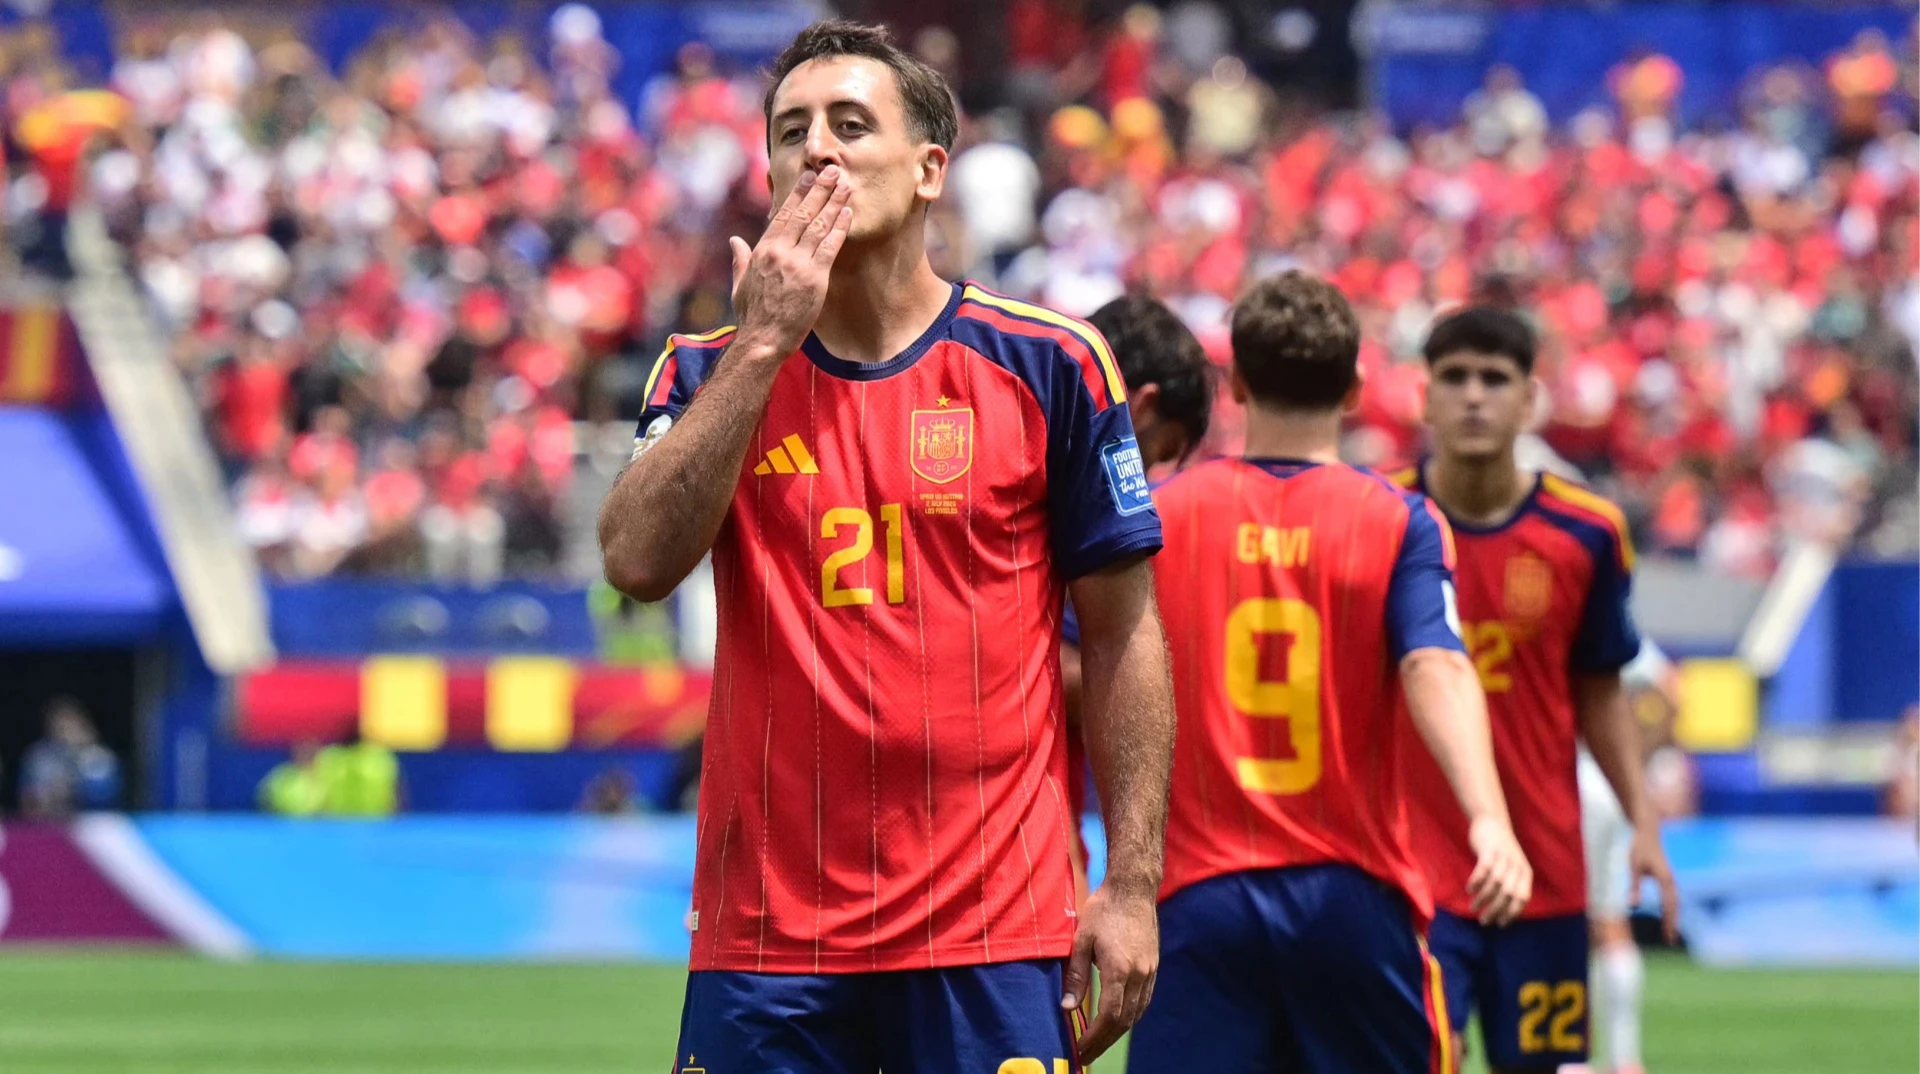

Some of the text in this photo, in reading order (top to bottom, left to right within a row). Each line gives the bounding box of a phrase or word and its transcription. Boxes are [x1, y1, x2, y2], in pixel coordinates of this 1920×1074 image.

[1119, 479, 1135, 494] the
[821, 503, 904, 608] 21
[1237, 522, 1310, 568] GAVI
[1225, 596, 1322, 795] 9
[1518, 980, 1585, 1054] 22
